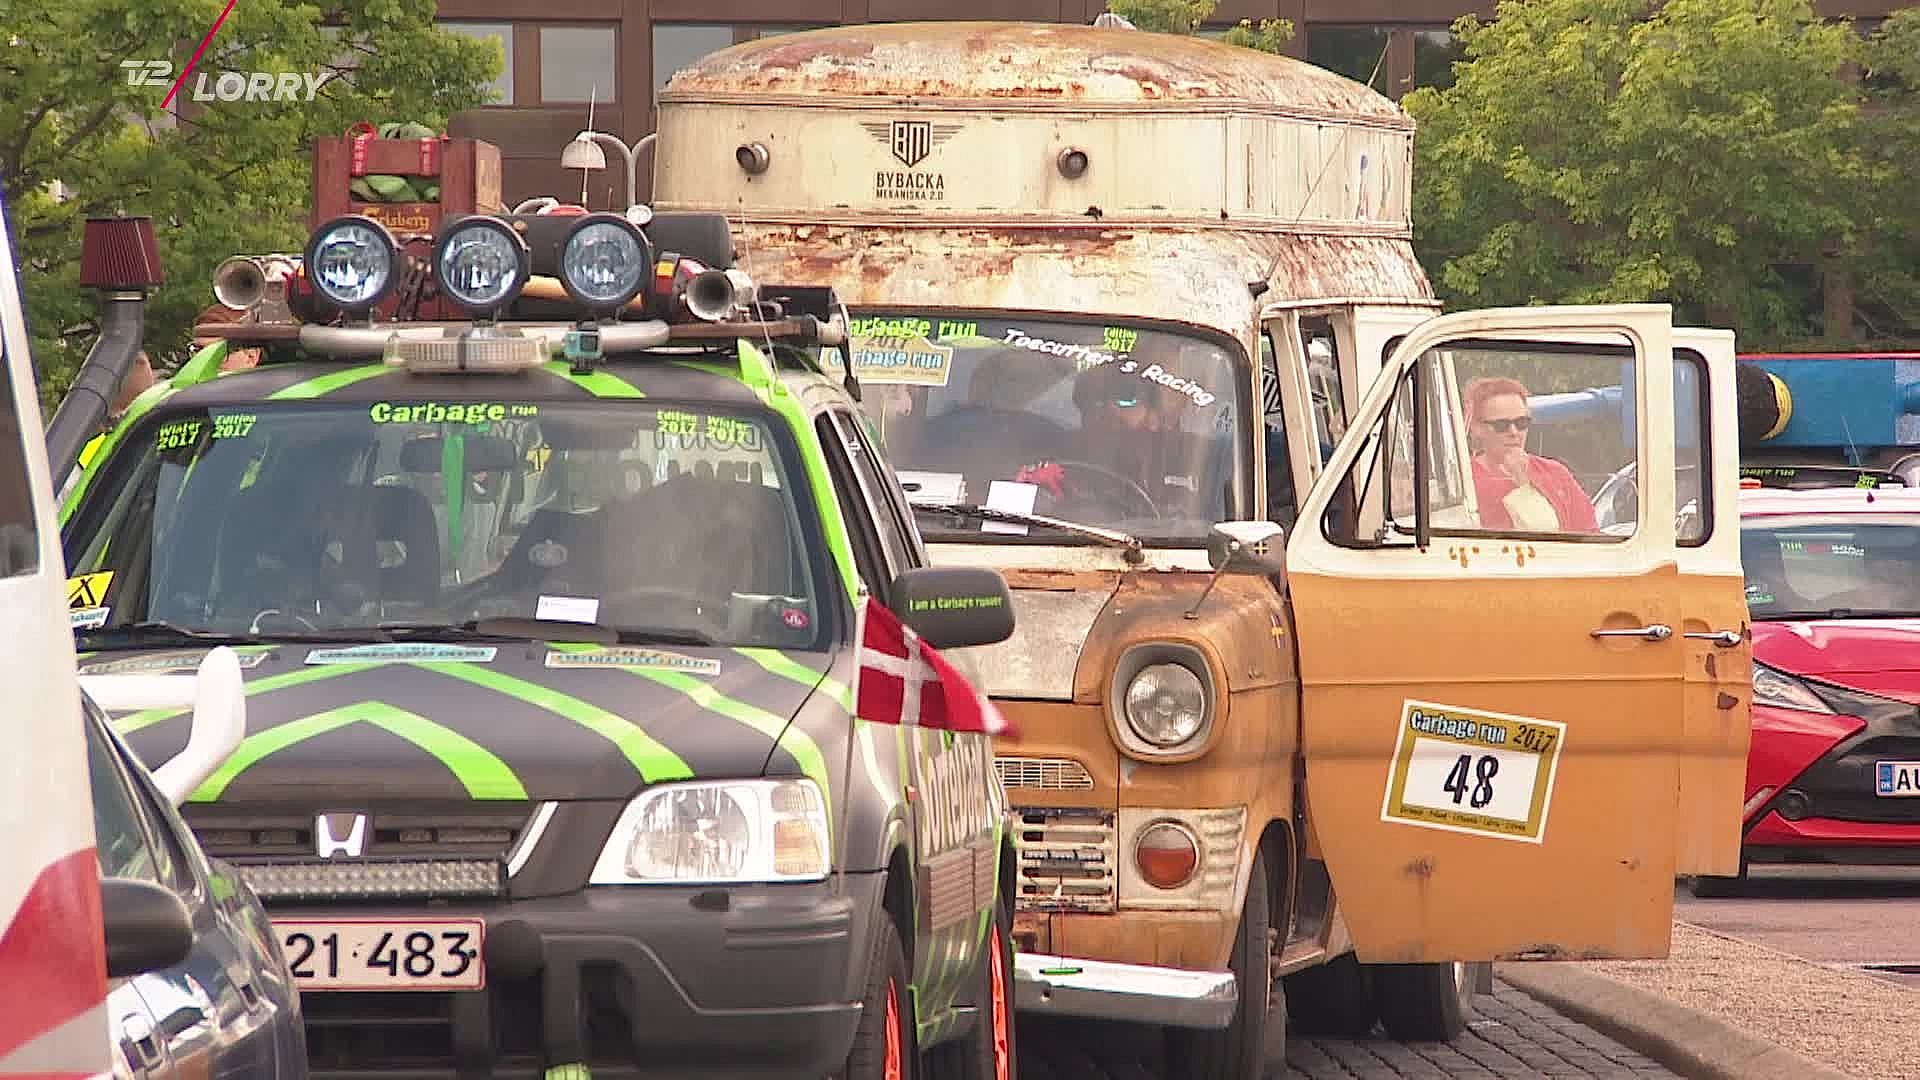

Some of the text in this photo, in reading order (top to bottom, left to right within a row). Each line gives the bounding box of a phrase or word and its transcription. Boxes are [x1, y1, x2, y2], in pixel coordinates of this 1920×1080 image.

[876, 172, 944, 189] BYBACKA
[849, 317, 978, 338] arbage run
[1103, 337, 1138, 353] 2017
[910, 351, 943, 368] run
[1141, 363, 1217, 407] Racing
[211, 423, 254, 439] 2017
[656, 419, 697, 434] 2017
[705, 426, 747, 443] 2017
[157, 432, 200, 450] 2017
[1478, 723, 1507, 744] run
[1512, 724, 1556, 754] 2017
[1443, 754, 1499, 808] 48
[285, 931, 472, 978] 21 483
